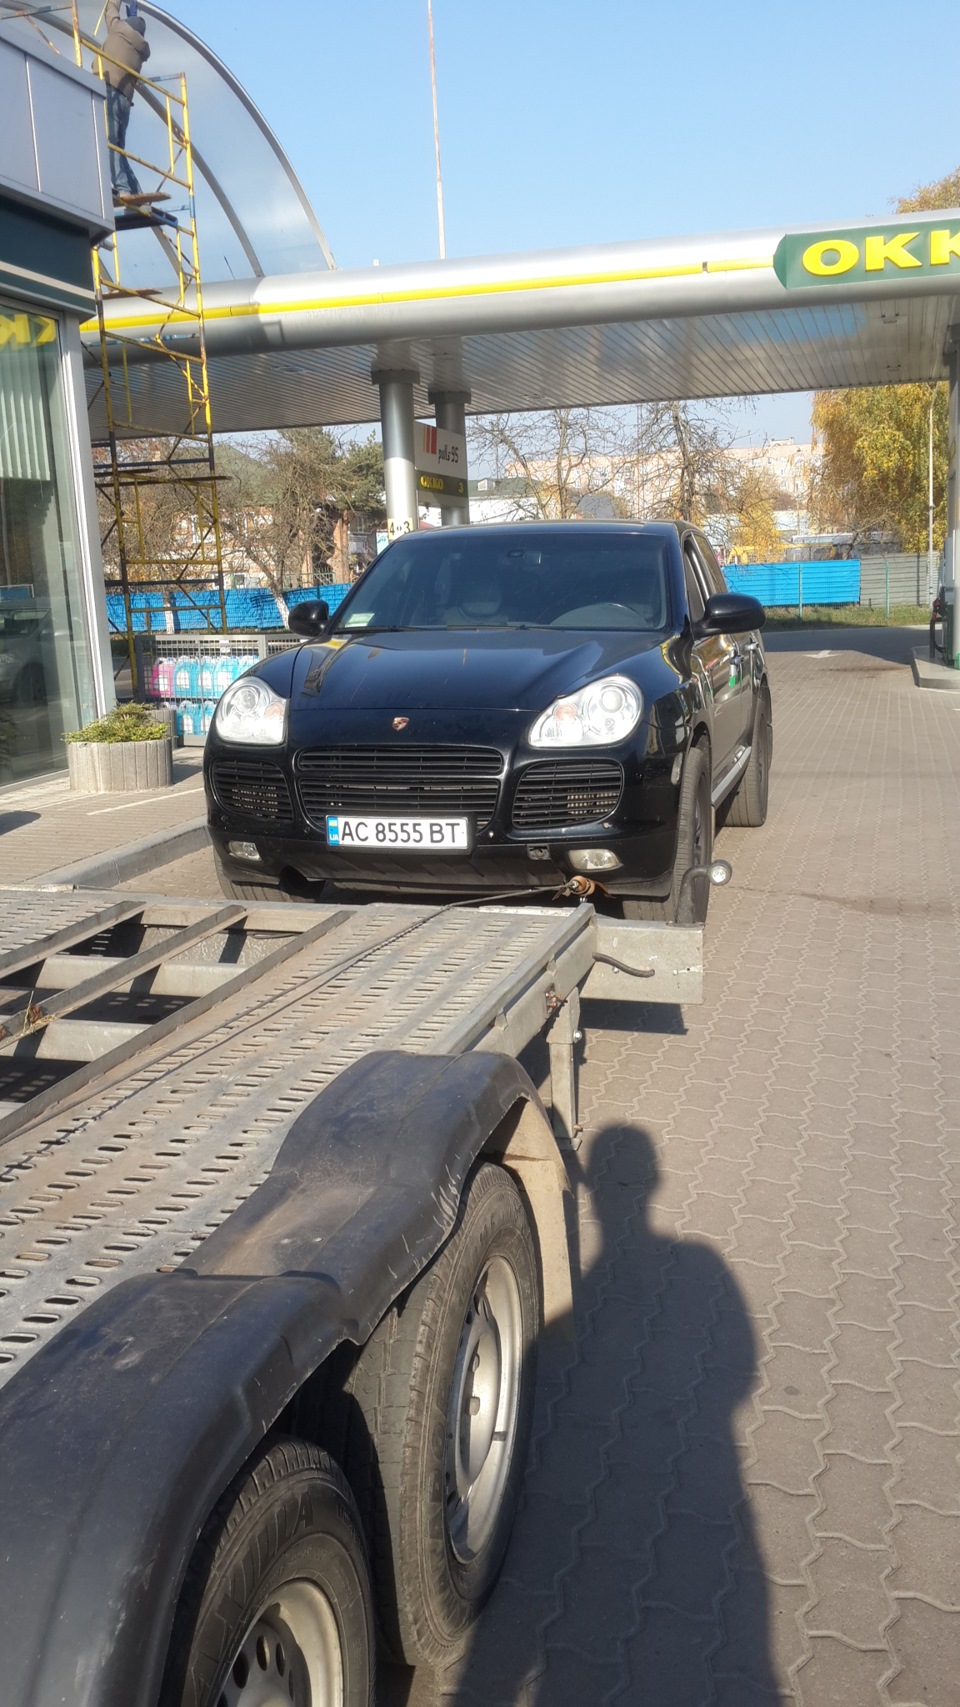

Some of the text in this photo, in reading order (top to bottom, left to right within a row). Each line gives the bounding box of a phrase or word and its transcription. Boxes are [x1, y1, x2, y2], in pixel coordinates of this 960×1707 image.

[389, 520, 411, 536] 4 3
[341, 821, 460, 843] AC 8555 BT
